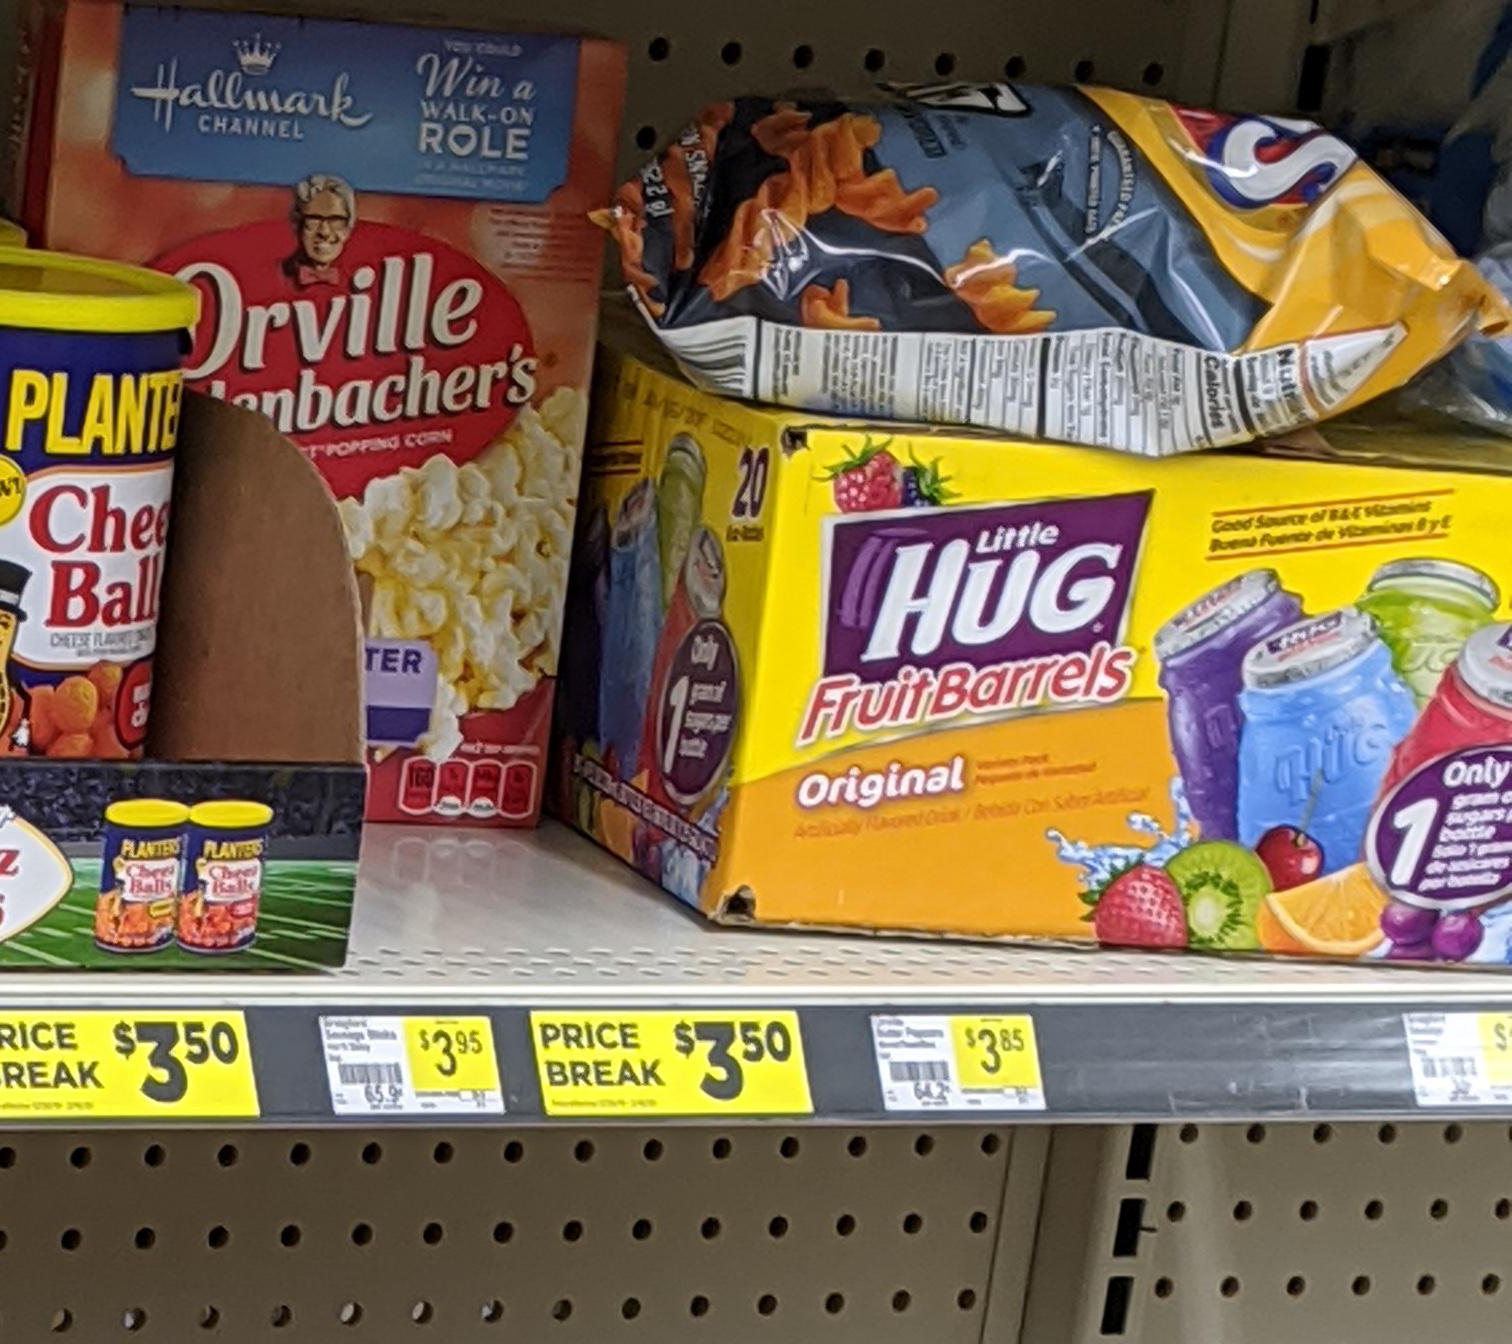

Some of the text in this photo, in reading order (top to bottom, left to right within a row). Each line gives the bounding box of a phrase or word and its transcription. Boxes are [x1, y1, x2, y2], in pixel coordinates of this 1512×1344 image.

[132, 58, 373, 132] Hallmark
[416, 53, 536, 100] Win a
[199, 116, 304, 140] CHANNEL
[420, 100, 534, 125] WALK-ON
[419, 122, 532, 160] ROLE
[172, 252, 483, 381] Orville
[324, 429, 453, 458] POPPING CORN
[732, 446, 767, 520] 20
[29, 485, 170, 555] Chee
[976, 522, 1060, 554] Little
[1212, 519, 1253, 533] Good
[1256, 514, 1308, 528] Source
[45, 560, 158, 629] Ball
[860, 539, 1123, 662] HUG
[662, 678, 689, 774] 1
[798, 756, 966, 808] Original
[1443, 756, 1510, 789] Only
[122, 838, 180, 859] PLANTERS
[204, 838, 263, 859] PLANTERS
[1391, 798, 1439, 886] 1
[539, 1021, 641, 1050] PRICE
[546, 1060, 666, 1086] BREAK
